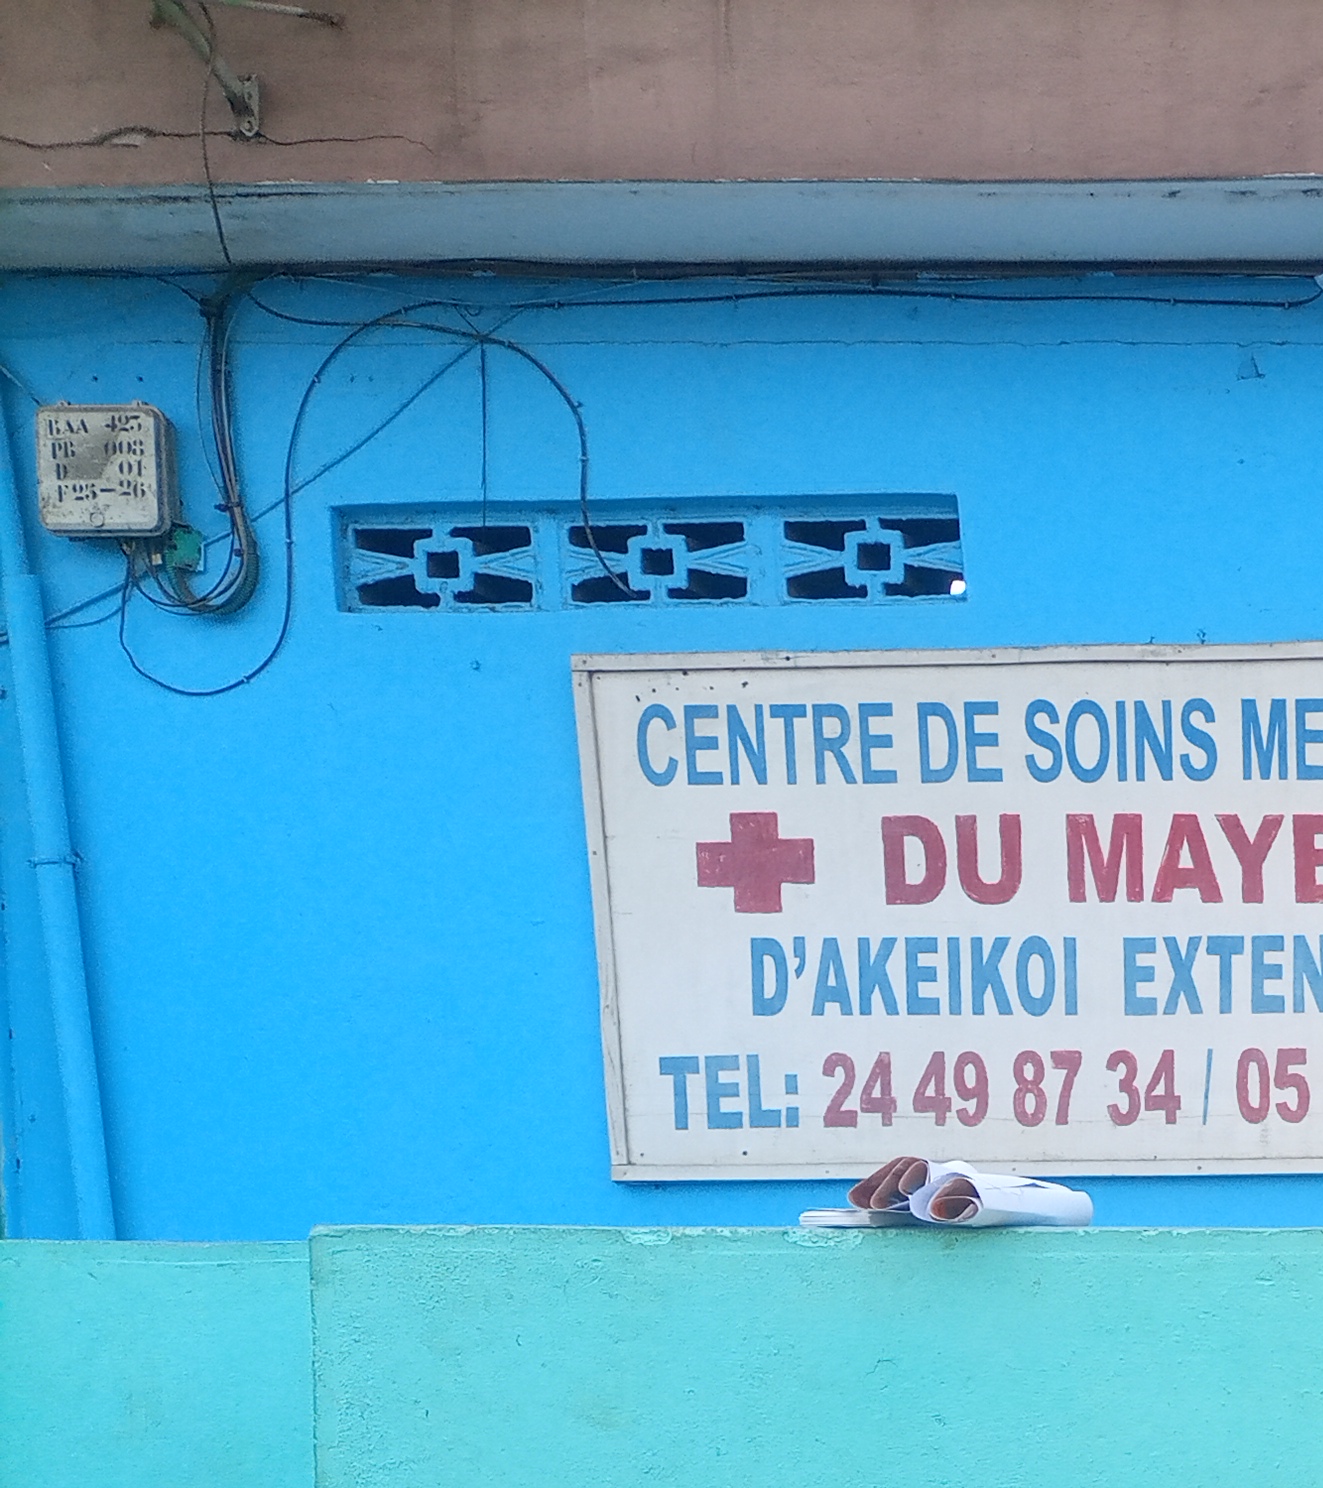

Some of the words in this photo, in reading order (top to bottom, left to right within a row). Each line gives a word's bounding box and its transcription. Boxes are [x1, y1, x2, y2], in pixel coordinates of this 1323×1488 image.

[636, 702, 899, 787] CENTRE
[917, 700, 1004, 784] DE
[1024, 697, 1218, 783] SOINS
[881, 813, 1022, 906] DU
[750, 935, 1079, 1017] D'AKEIKOI
[659, 1053, 801, 1131] TEL:
[822, 1051, 898, 1129] 24
[913, 1050, 990, 1128] 49
[1013, 1049, 1083, 1128] 87
[1105, 1048, 1182, 1127] 34
[1236, 1047, 1311, 1125] 05
